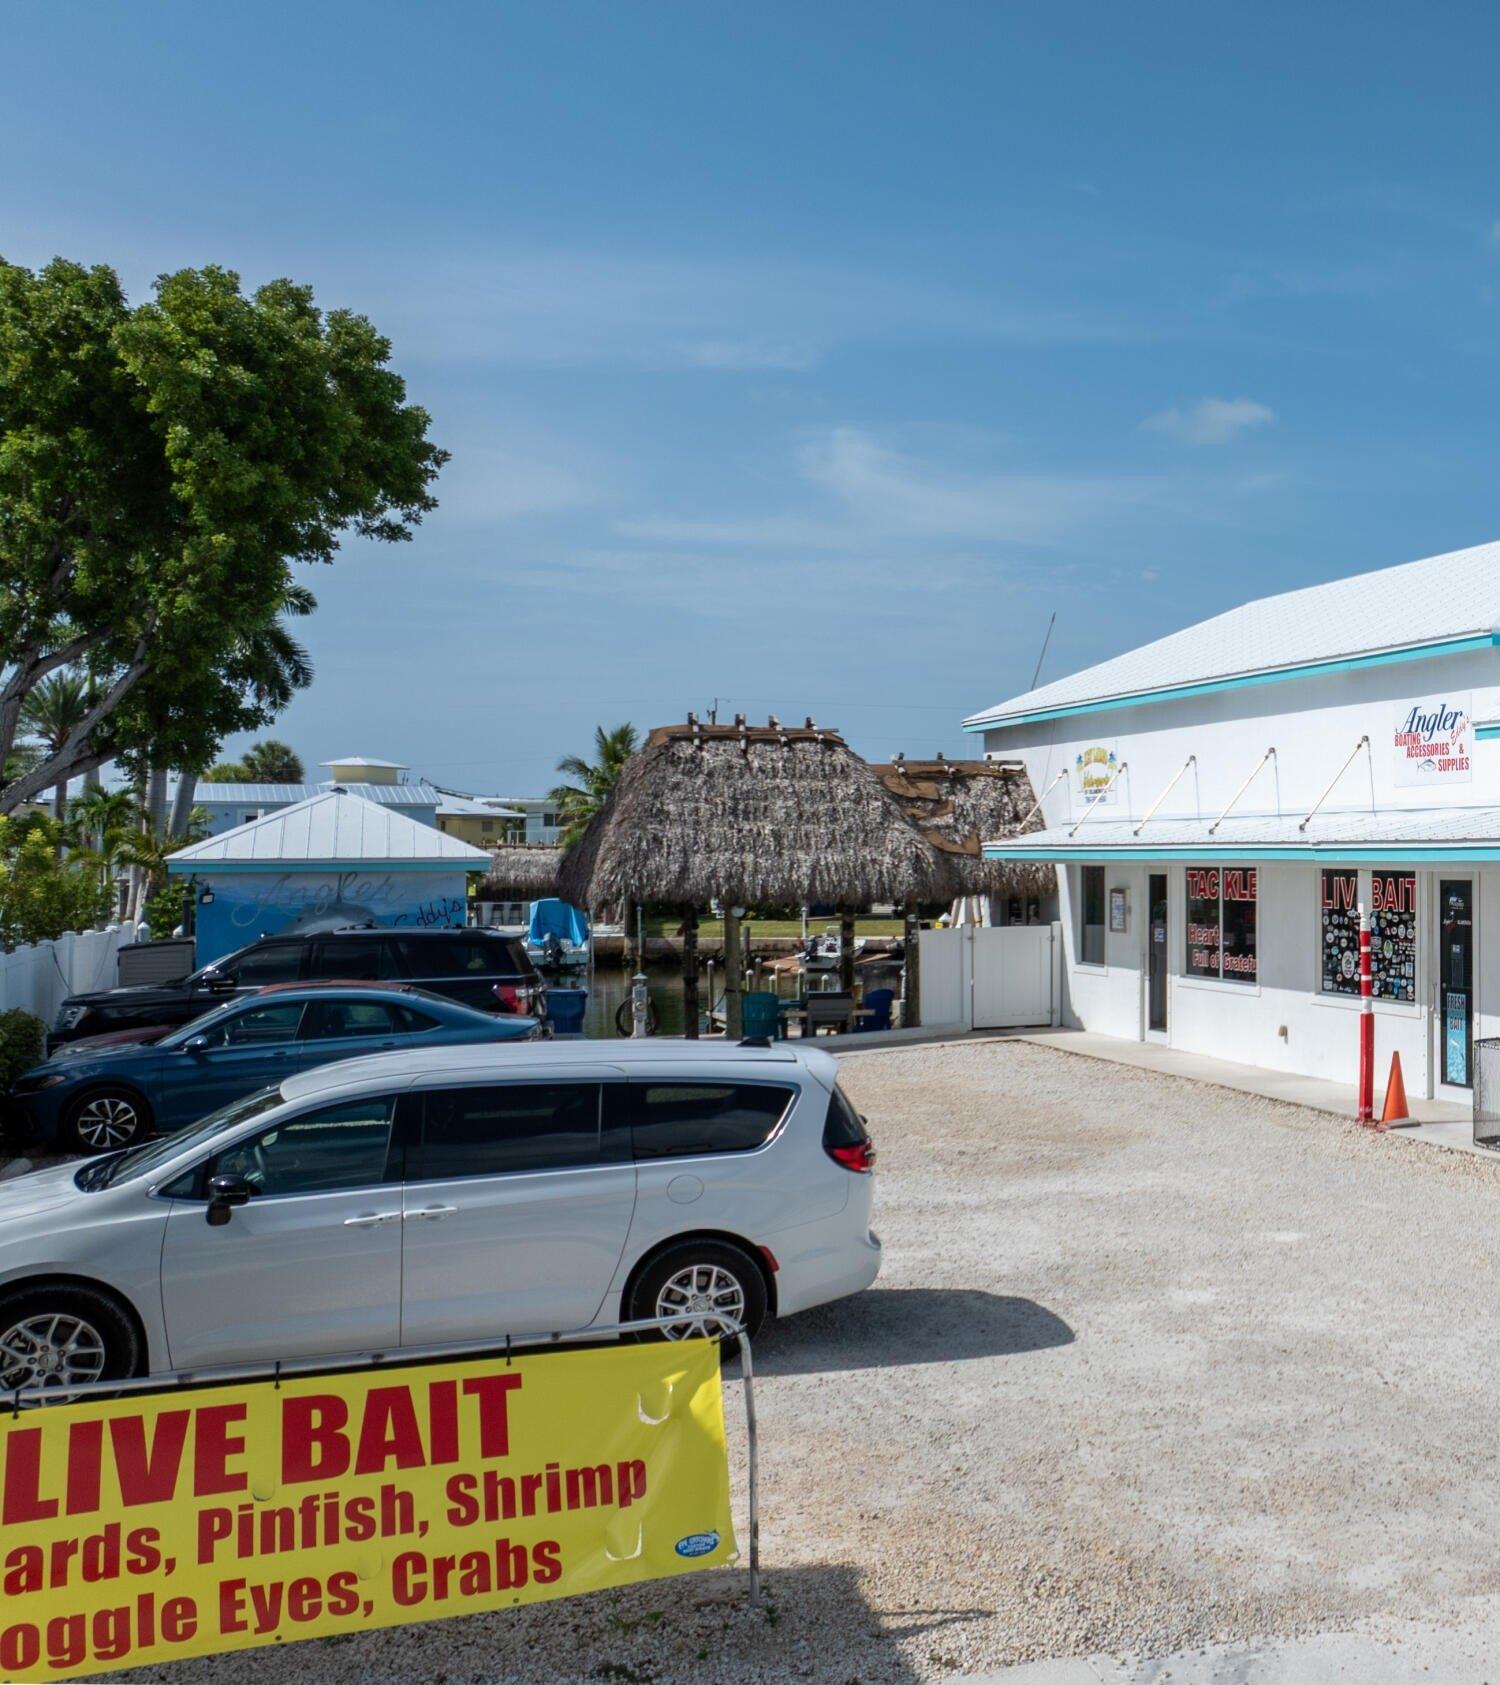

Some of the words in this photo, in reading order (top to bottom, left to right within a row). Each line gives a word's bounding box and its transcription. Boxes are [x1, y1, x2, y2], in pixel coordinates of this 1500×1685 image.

[1395, 704, 1463, 743] Angler
[1394, 732, 1421, 747] BOATING
[1406, 742, 1450, 758] ACCESSORIES
[1458, 743, 1464, 754] &
[1438, 757, 1470, 772] SUPPLIES
[231, 872, 406, 927] Angler
[1187, 871, 1257, 900] TACKLE
[1322, 877, 1357, 909] LIV
[1372, 878, 1416, 912] BAIT
[1188, 923, 1220, 946] Heart
[1192, 949, 1209, 967] Full
[1450, 1016, 1463, 1031] BAIT
[2, 1402, 248, 1526] LIVE
[282, 1373, 522, 1486] BAIT
[3, 1522, 176, 1597] ards,
[197, 1483, 431, 1565] Pinfish,
[446, 1458, 647, 1528] Shrimp
[0, 1592, 198, 1671] oggle
[219, 1575, 375, 1635] Eyes,
[392, 1539, 562, 1607] Crabs
